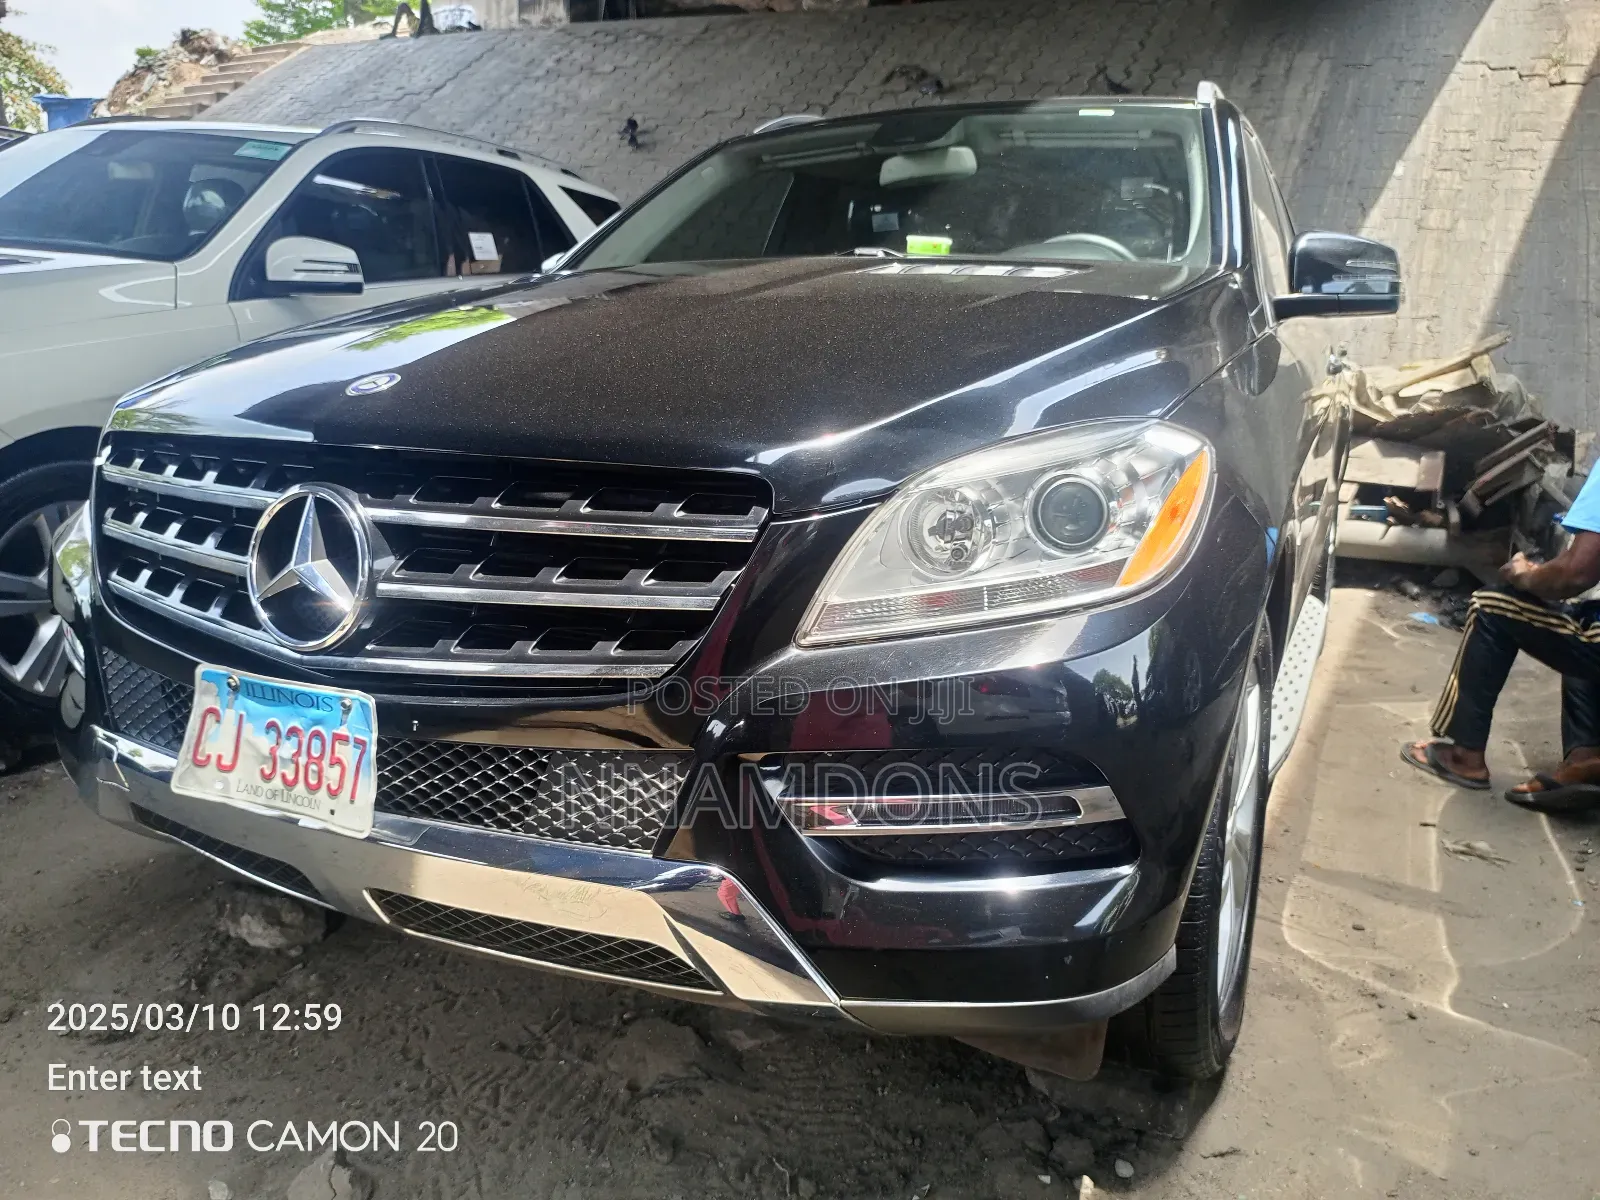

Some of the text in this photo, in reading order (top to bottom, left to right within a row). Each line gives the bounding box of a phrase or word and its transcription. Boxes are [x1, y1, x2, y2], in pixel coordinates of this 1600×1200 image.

[245, 681, 333, 712] ILLINOIS
[192, 707, 367, 802] CJ 33857
[236, 779, 321, 811] LAND OF LINCOLN
